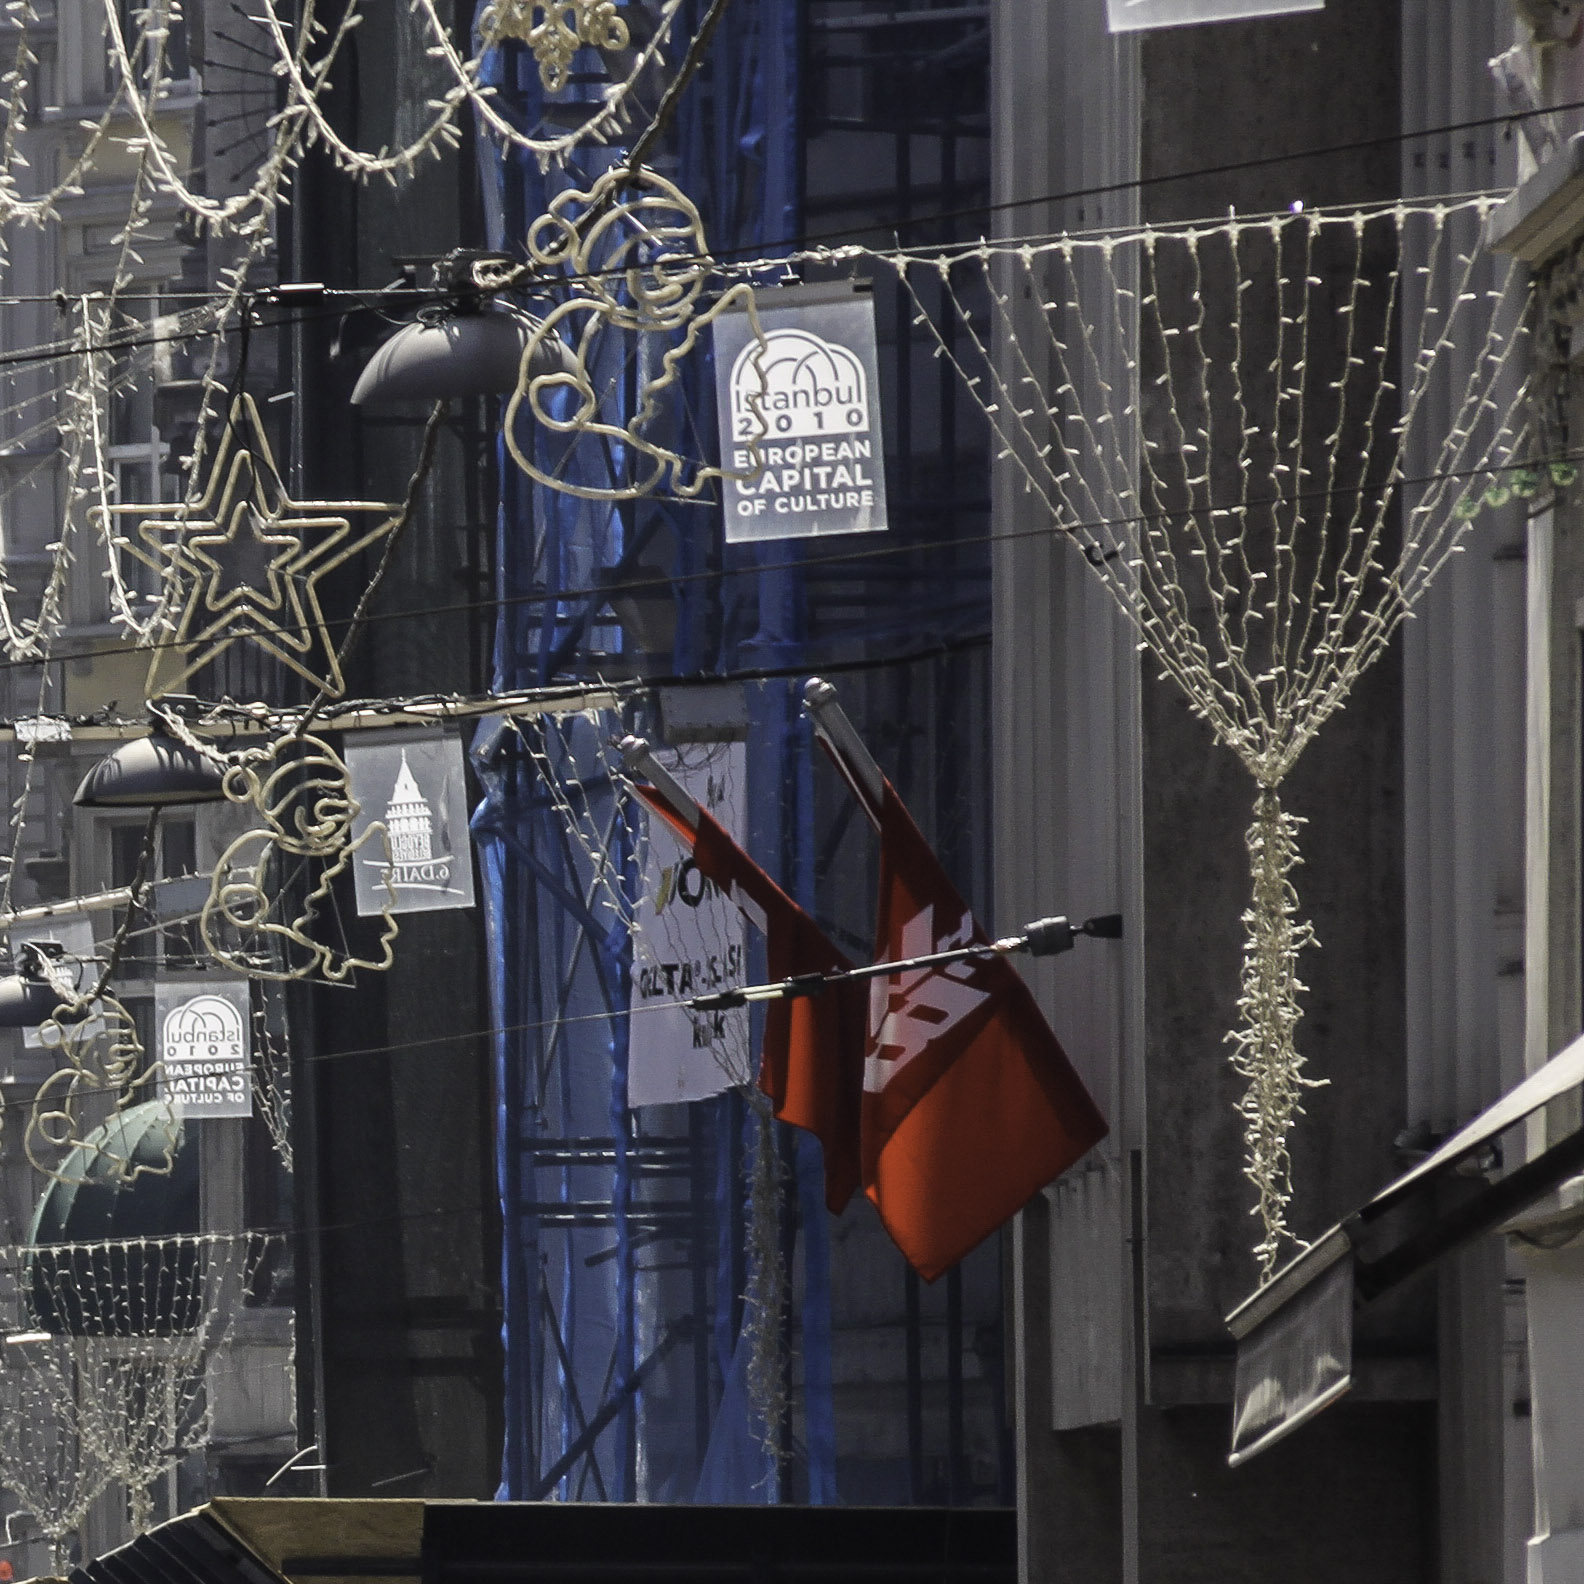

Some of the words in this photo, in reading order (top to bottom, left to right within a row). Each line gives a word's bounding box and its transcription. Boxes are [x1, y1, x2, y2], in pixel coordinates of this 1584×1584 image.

[734, 438, 872, 468] EUROPEAN
[736, 463, 873, 496] CAPITAL
[737, 501, 766, 517] OF
[774, 490, 874, 516] CULTURE
